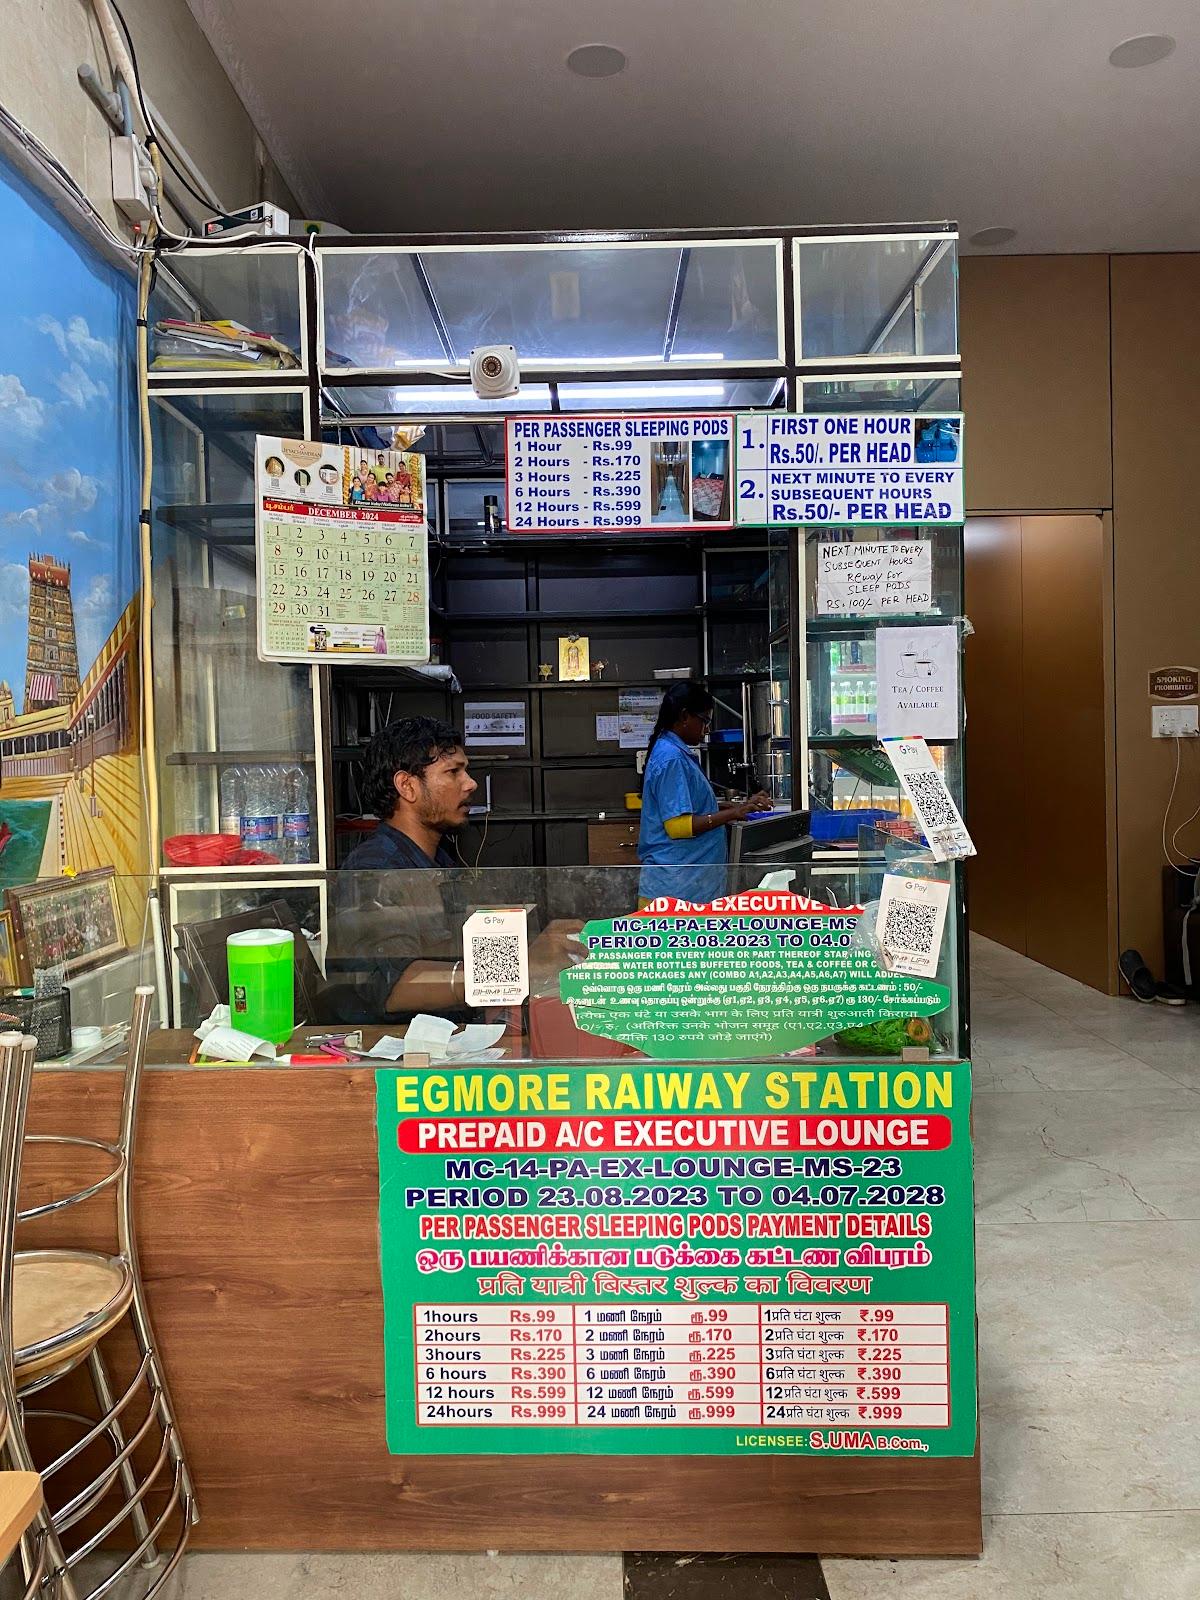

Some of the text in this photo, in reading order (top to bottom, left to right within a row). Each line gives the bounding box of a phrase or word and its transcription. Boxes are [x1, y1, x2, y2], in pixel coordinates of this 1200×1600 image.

[514, 419, 728, 438] PER PASSENGER SLEEPING PODS
[771, 418, 911, 435] FIRST ONE HOUR
[742, 428, 765, 449] 1.
[514, 440, 632, 452] 1 Hour Rs.99
[829, 443, 861, 463] PER
[867, 442, 911, 463] HEAD
[514, 456, 641, 467] 2 Hours Rs.170
[515, 471, 641, 482] 3 Hours Rs.225
[771, 472, 955, 485] NEXT MINUTE TO EVERY
[515, 486, 641, 497] 6 Hours Rs.390
[739, 479, 764, 499] 2.
[771, 488, 932, 501] SUBSEQUENT HOURS
[515, 500, 641, 512] 12 Hours Rs.599
[772, 502, 951, 520] Rs.50/- PER HEAD
[308, 507, 379, 520] DECEMBER 2024
[515, 516, 642, 527] 24 Hours Rs.999
[317, 548, 396, 564] 10 12 13
[823, 544, 851, 559] NEXT
[854, 543, 888, 556] MINUTE
[900, 545, 924, 557] EVERY
[824, 557, 913, 573] SUBSEQUENT HOURS
[295, 566, 418, 584] 16 18 19 20 21
[847, 581, 911, 596] SLEEP PODS
[881, 595, 900, 607] PER
[906, 593, 929, 603] HEAD
[492, 916, 505, 925] Pay
[588, 934, 804, 949] PERIOD 23.08.2023 TO
[598, 952, 653, 960] PASSANGER
[655, 951, 673, 960] FOR
[675, 951, 706, 960] EVERY
[708, 951, 734, 959] HOUR
[737, 951, 750, 959] OR
[752, 951, 776, 959] PART
[623, 961, 655, 970] WATER
[656, 961, 698, 969] BOTTLES
[700, 961, 747, 969] BUFFETED
[750, 960, 784, 969] FOODS,
[786, 961, 805, 969] TEA
[816, 960, 853, 968] COFFEE
[855, 960, 868, 968] OR
[604, 971, 635, 980] FOODS
[637, 971, 686, 980] PACKAGES
[688, 971, 707, 979] ANY
[709, 970, 746, 980] (COMBO
[850, 970, 872, 978] WILL
[396, 1070, 953, 1113] EGMORE RAIWAY STATION
[418, 1119, 929, 1149] PREPAID A/C EXECUTIVE LOUNGE
[446, 1157, 901, 1180] MC-14-PA-EX-LOUNGE-MS-23
[405, 1185, 945, 1208] PERIOD 23.08.2023 TO 04.07.2028
[420, 1212, 931, 1239] PER PASSENGER SLEEPING PODS PAYMENT DETAILS
[416, 1240, 932, 1274] ஒரு பயணிக்கான படுக்கை கட்டண விபரம்
[477, 1270, 873, 1301] प्रति यात्री बिस्तर शुल्क का विवरण
[509, 1310, 556, 1322] Rs.99
[510, 1329, 562, 1342] Rs.170
[510, 1348, 566, 1361] Rs.225
[426, 1366, 566, 1380] 6 hours Rs.390
[426, 1386, 566, 1399] 12 hours Rs.599
[511, 1405, 566, 1418] Rs.999
[736, 1435, 808, 1448] LICENSEE:
[809, 1431, 876, 1450] S.UMA
